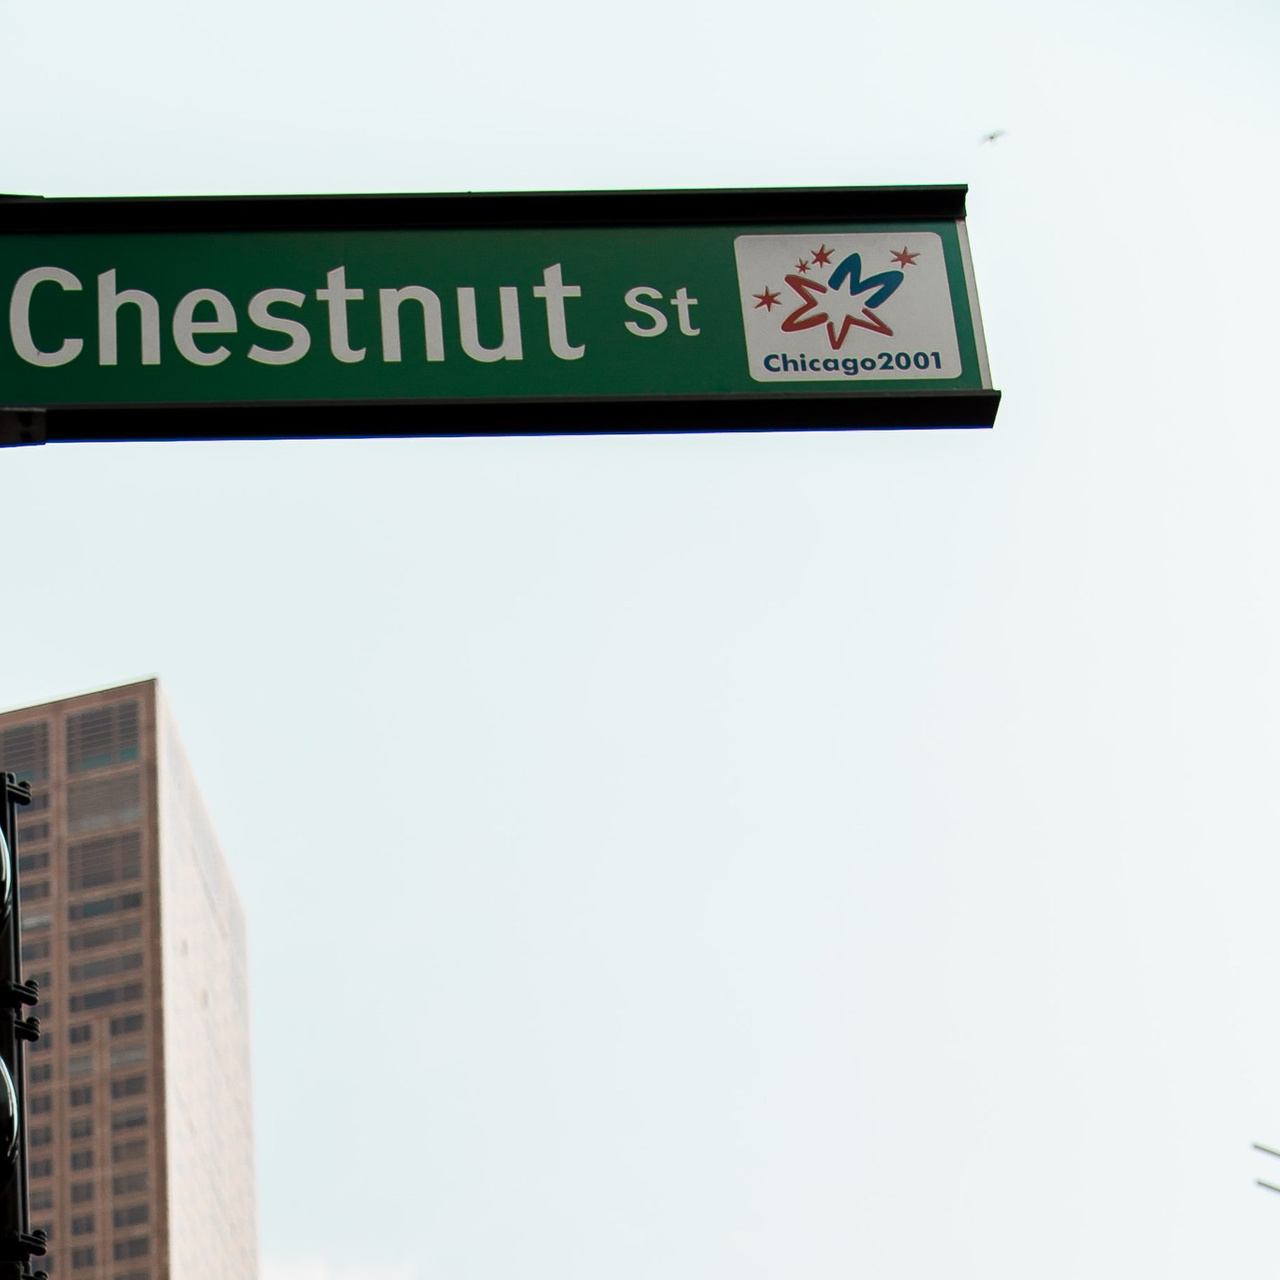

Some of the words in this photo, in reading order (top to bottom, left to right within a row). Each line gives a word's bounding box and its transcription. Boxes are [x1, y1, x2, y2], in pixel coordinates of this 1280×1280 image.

[8, 263, 586, 368] Chestnut
[623, 285, 701, 337] St
[762, 350, 943, 376] Chicago2001
